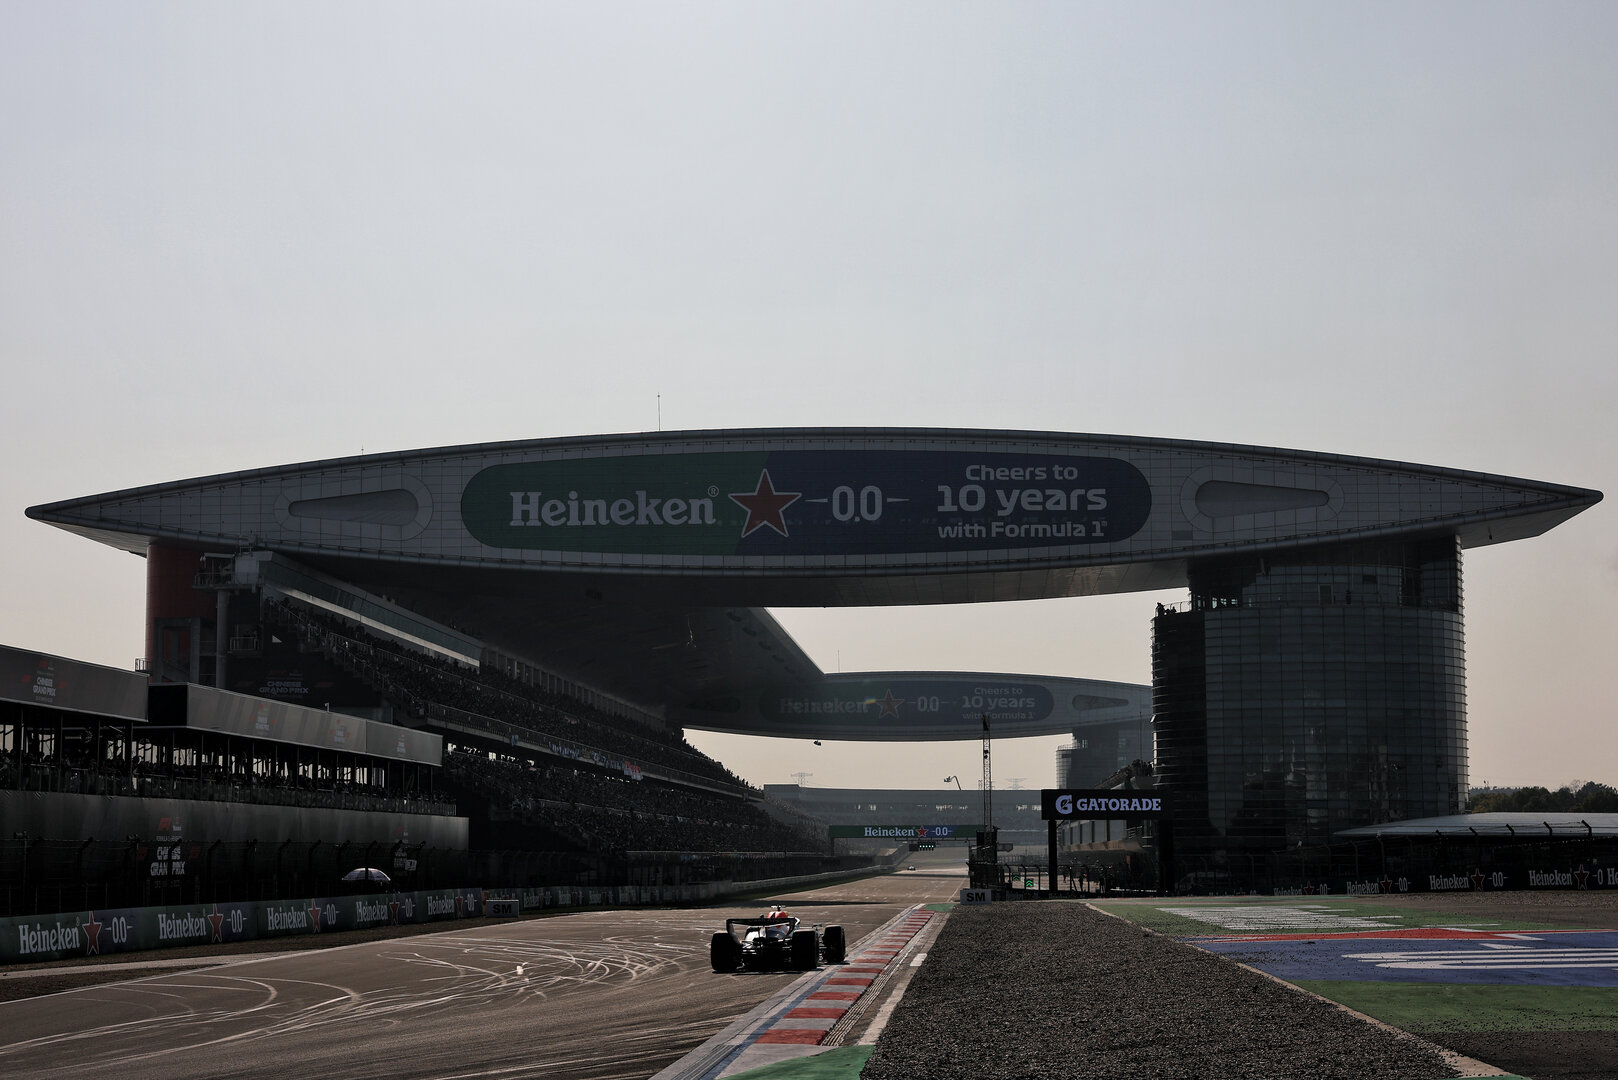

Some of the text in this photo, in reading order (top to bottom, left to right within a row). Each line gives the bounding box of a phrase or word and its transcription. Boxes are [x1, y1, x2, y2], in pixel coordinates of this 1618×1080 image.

[965, 464, 1078, 481] Cheers to
[832, 485, 883, 522] 0.0
[937, 485, 1108, 516] 10 years
[937, 522, 987, 538] with
[991, 521, 1087, 537] Formula
[974, 687, 1023, 696] Cheers to
[961, 695, 1036, 710] 10 years
[1076, 798, 1162, 812] GATORADE
[864, 826, 916, 837] Heineken
[1428, 873, 1470, 891] Heineken
[1529, 868, 1573, 887] Heineken
[966, 893, 986, 901] SM
[355, 898, 389, 923] Heineken
[492, 904, 512, 913] SM
[158, 911, 207, 940] Heineken
[266, 904, 308, 931] Heineken
[111, 916, 128, 944] 0.0
